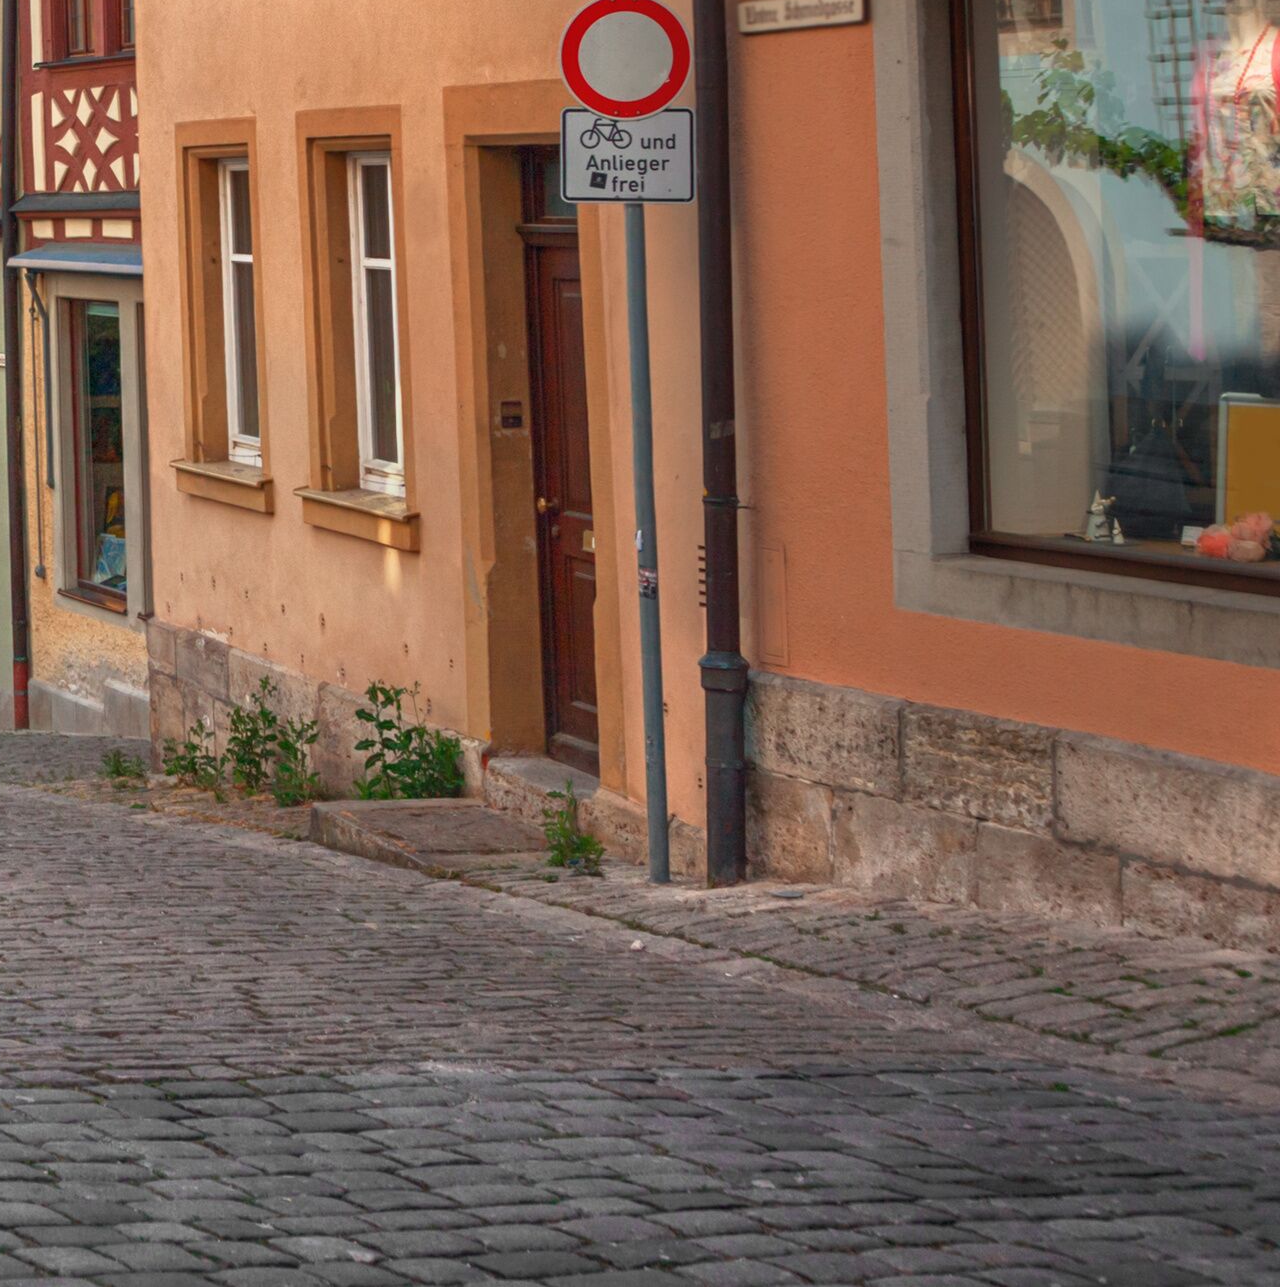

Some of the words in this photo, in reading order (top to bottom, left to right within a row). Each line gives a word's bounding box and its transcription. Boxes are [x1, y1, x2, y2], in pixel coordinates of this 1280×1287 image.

[640, 133, 676, 150] und
[585, 155, 670, 175] Anlieger
[611, 176, 645, 192] frei
